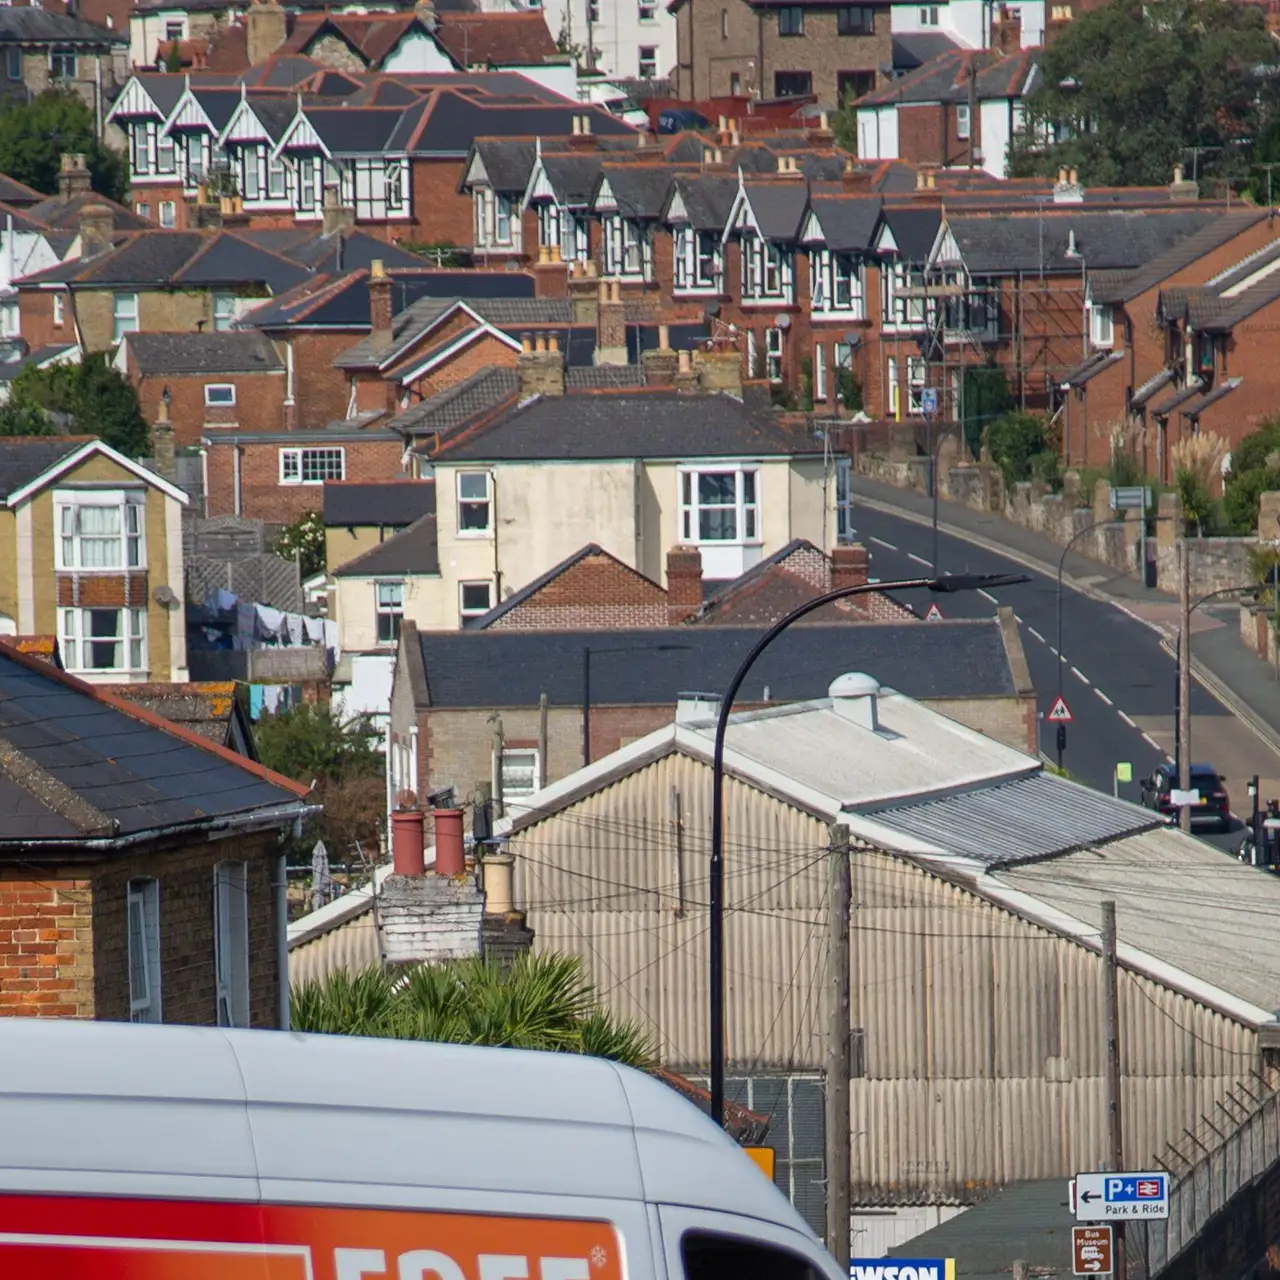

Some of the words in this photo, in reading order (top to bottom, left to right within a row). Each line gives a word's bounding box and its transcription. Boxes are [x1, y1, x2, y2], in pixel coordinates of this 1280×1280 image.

[1105, 1205, 1128, 1214] Park
[1132, 1205, 1138, 1213] &
[1142, 1204, 1164, 1213] Ride
